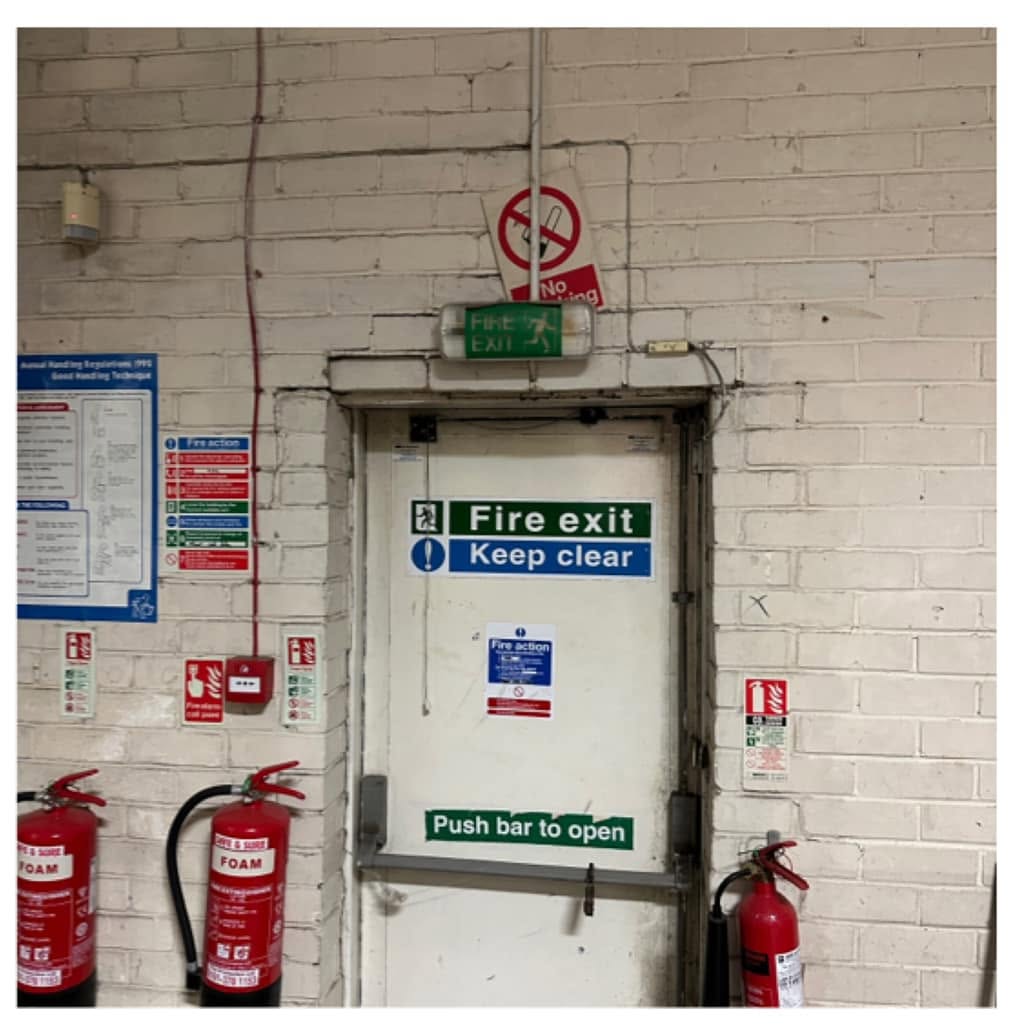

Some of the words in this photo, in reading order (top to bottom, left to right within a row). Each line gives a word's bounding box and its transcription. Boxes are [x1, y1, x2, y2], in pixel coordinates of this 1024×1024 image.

[471, 314, 514, 332] FIRE
[472, 336, 512, 352] EXIT
[187, 439, 207, 448] Fire
[209, 439, 240, 448] action
[470, 505, 545, 532] Fire
[558, 507, 634, 534] exit
[470, 543, 546, 570] Keep
[557, 545, 633, 568] clear
[492, 640, 512, 650] Fire
[515, 642, 550, 652] action
[433, 815, 489, 836] Push
[495, 817, 534, 838] bar
[539, 820, 561, 839] to
[568, 823, 625, 844] open
[221, 856, 262, 869] FOAM
